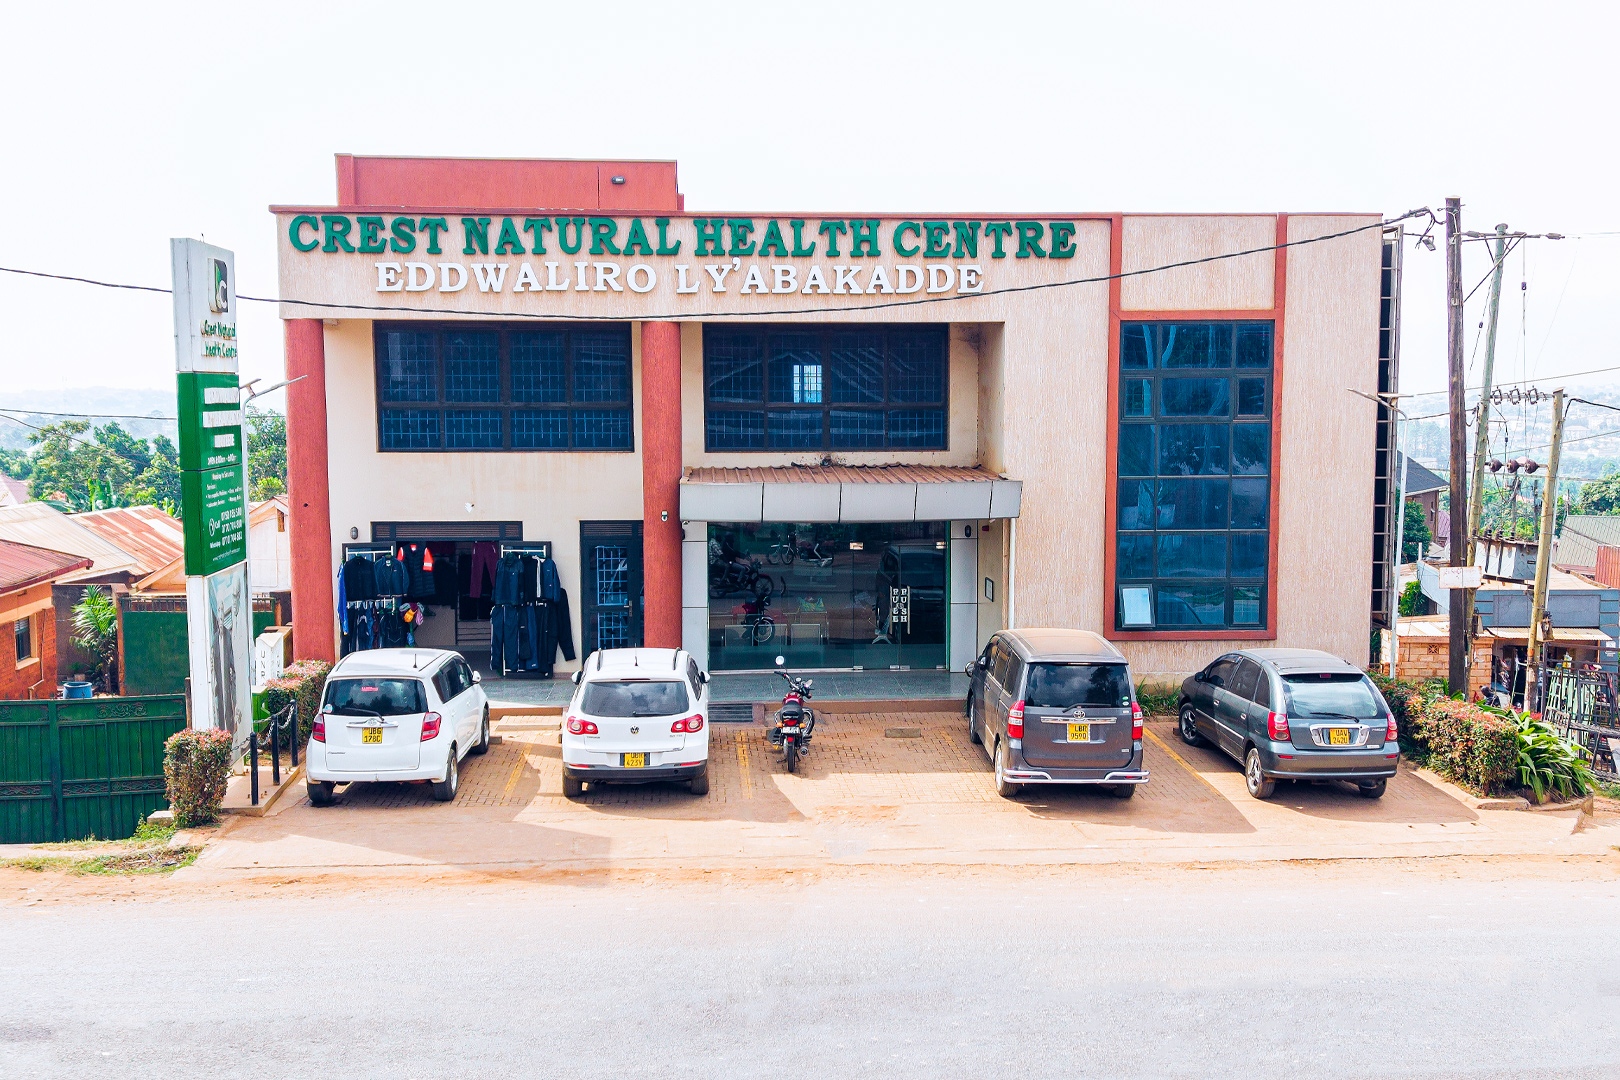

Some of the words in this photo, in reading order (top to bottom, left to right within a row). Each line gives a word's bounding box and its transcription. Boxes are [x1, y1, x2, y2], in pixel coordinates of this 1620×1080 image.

[289, 215, 449, 255] CREST
[462, 216, 682, 256] NATURAL
[693, 218, 882, 257] HEALTH
[893, 220, 1078, 259] CENTRE
[375, 261, 657, 294] EDDWALIRO
[676, 257, 985, 295] LY'ABAKADDE
[204, 319, 217, 335] Crest
